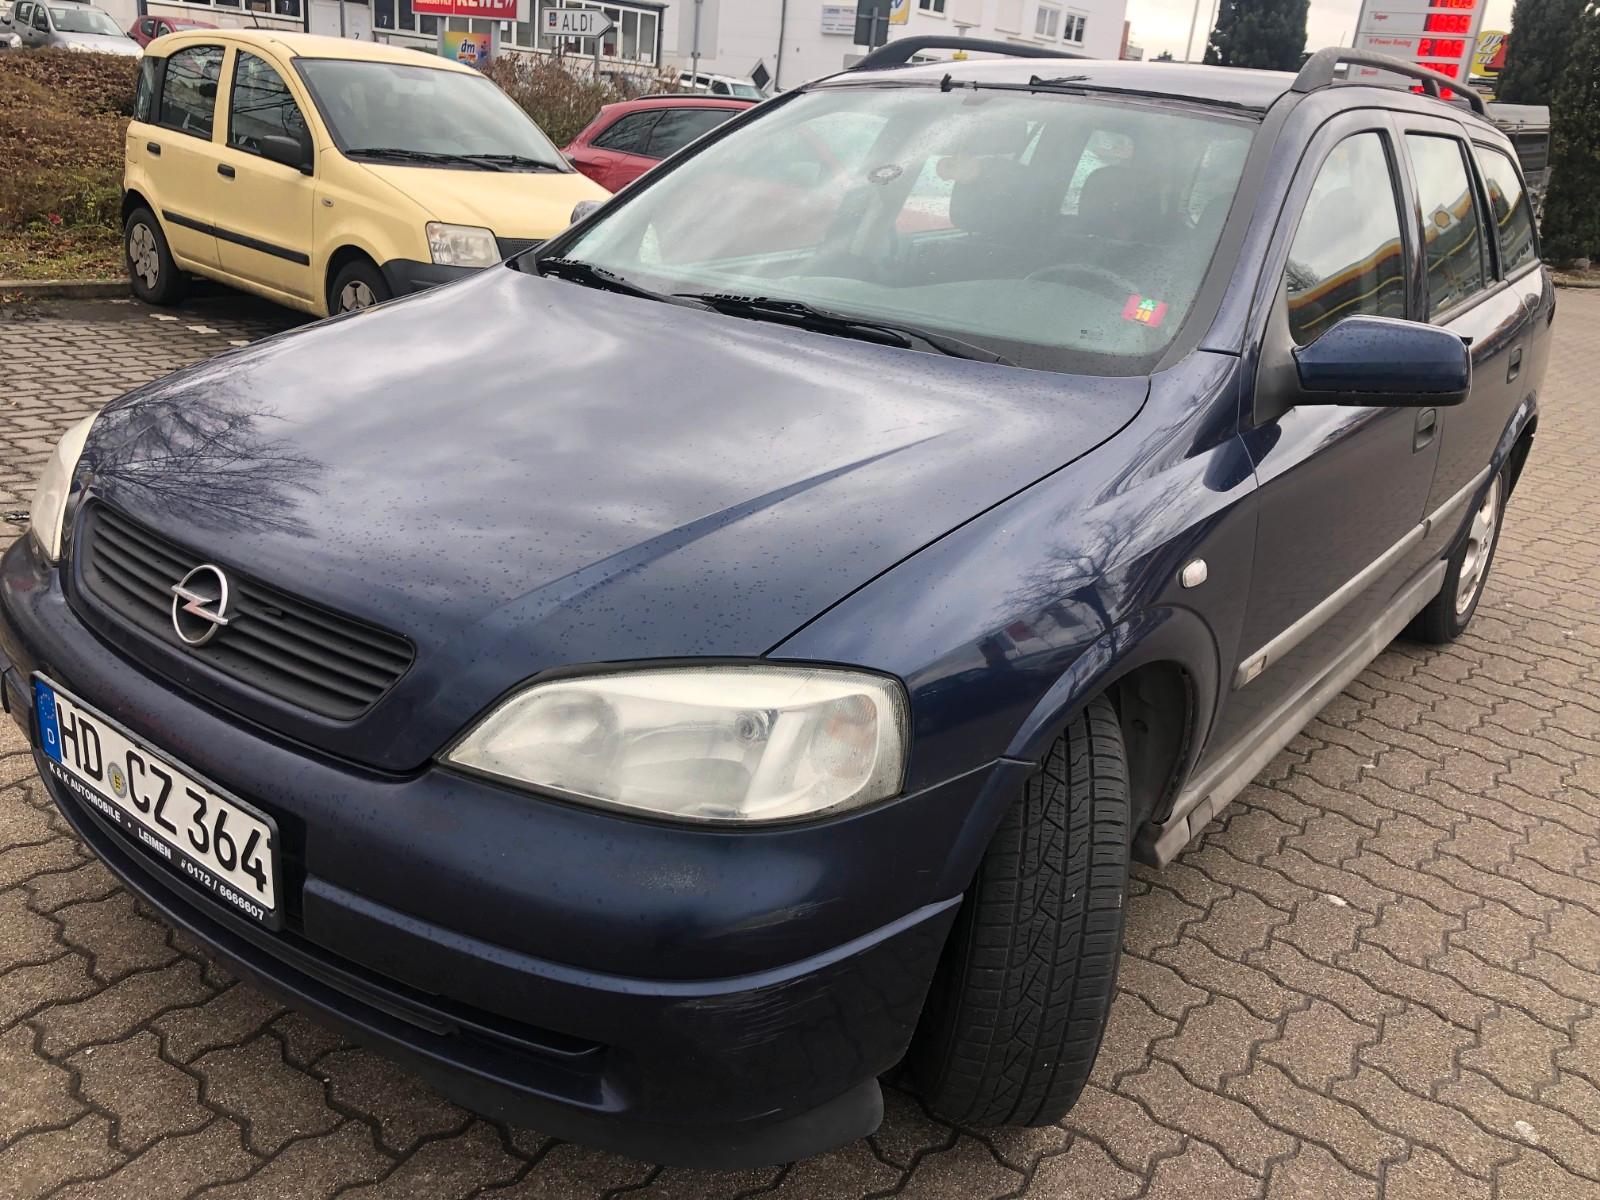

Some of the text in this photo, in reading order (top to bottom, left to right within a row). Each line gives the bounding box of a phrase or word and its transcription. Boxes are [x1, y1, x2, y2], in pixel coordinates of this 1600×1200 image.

[562, 13, 593, 32] ALDI
[461, 39, 475, 54] dm
[47, 728, 55, 744] D
[56, 701, 267, 893] HD CZ 364
[63, 773, 70, 784] K
[70, 780, 121, 822] AUTOMOBILE
[138, 827, 172, 859] LEIMEN
